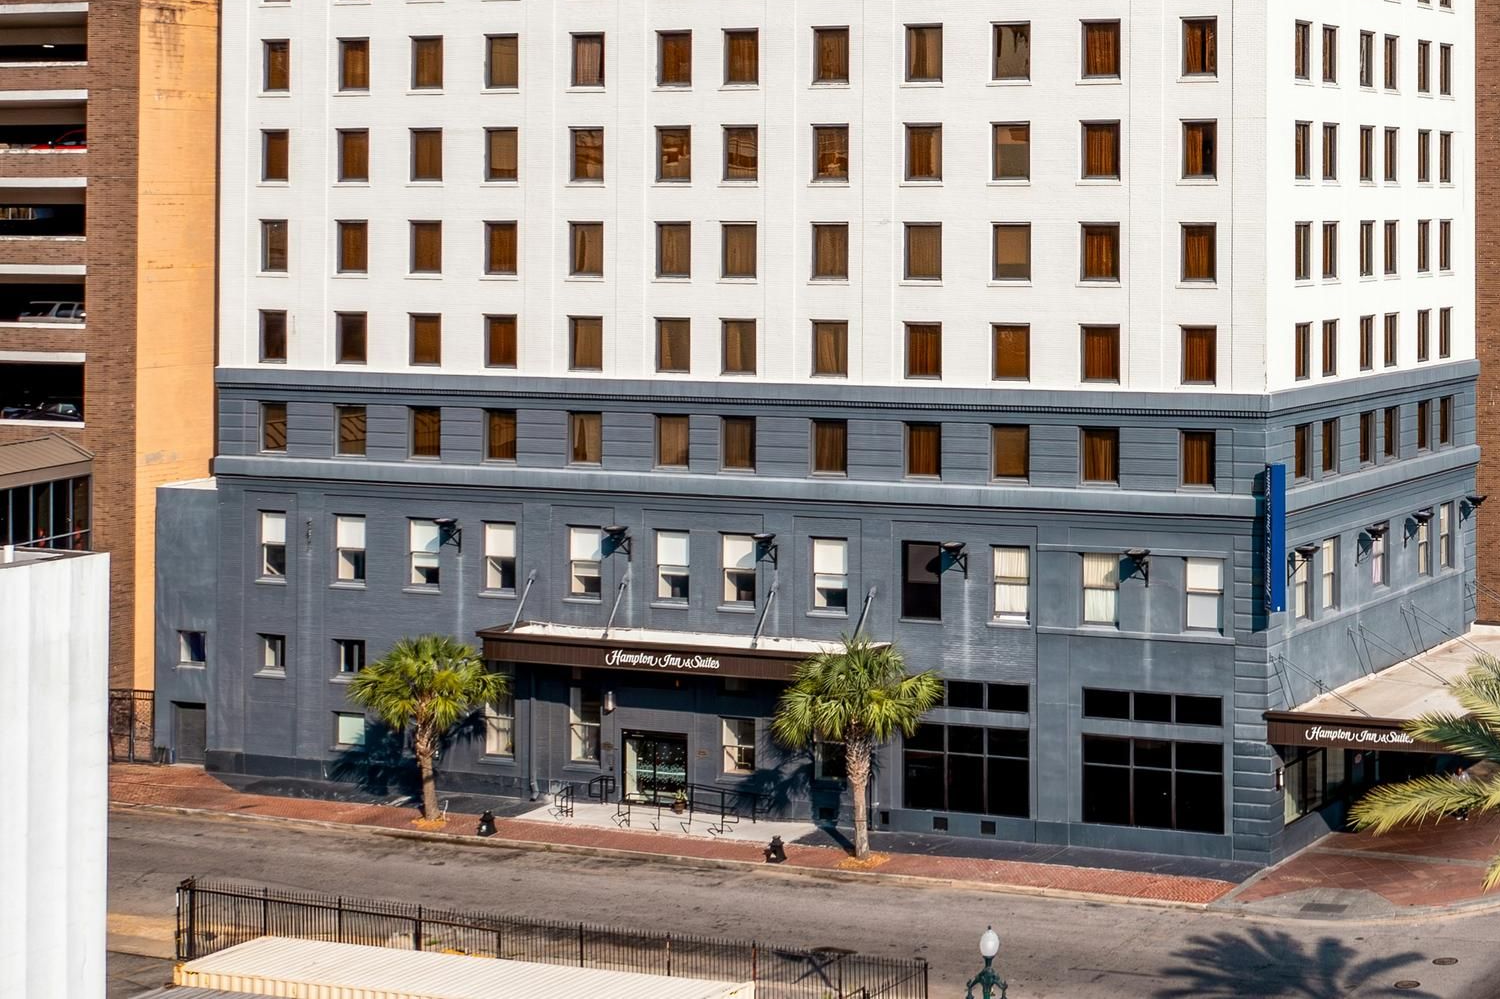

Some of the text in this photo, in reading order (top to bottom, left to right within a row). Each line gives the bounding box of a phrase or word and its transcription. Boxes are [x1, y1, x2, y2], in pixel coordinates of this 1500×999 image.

[605, 649, 657, 667] Hampton
[658, 654, 685, 668] Inn
[691, 655, 720, 669] Suites
[1305, 726, 1355, 741] Hampton
[1355, 730, 1381, 743] Inn
